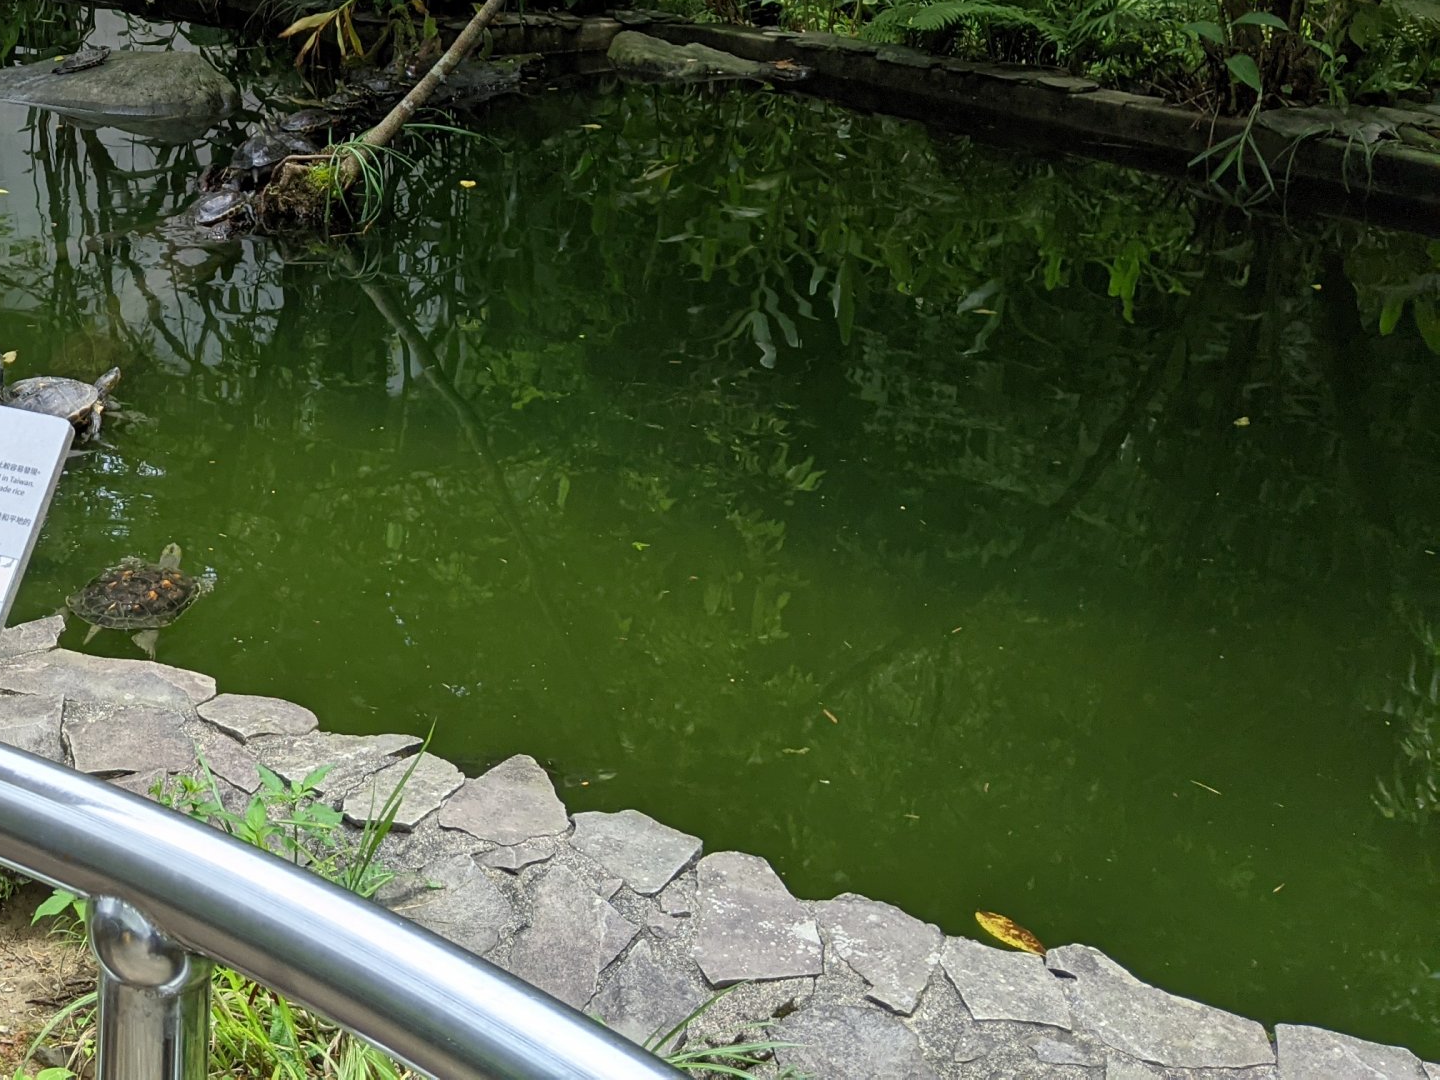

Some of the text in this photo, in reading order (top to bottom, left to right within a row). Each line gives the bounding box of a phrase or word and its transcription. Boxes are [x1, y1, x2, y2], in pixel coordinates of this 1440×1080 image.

[1, 474, 8, 482] in
[10, 476, 33, 487] Taiwan.
[12, 488, 25, 496] rice
